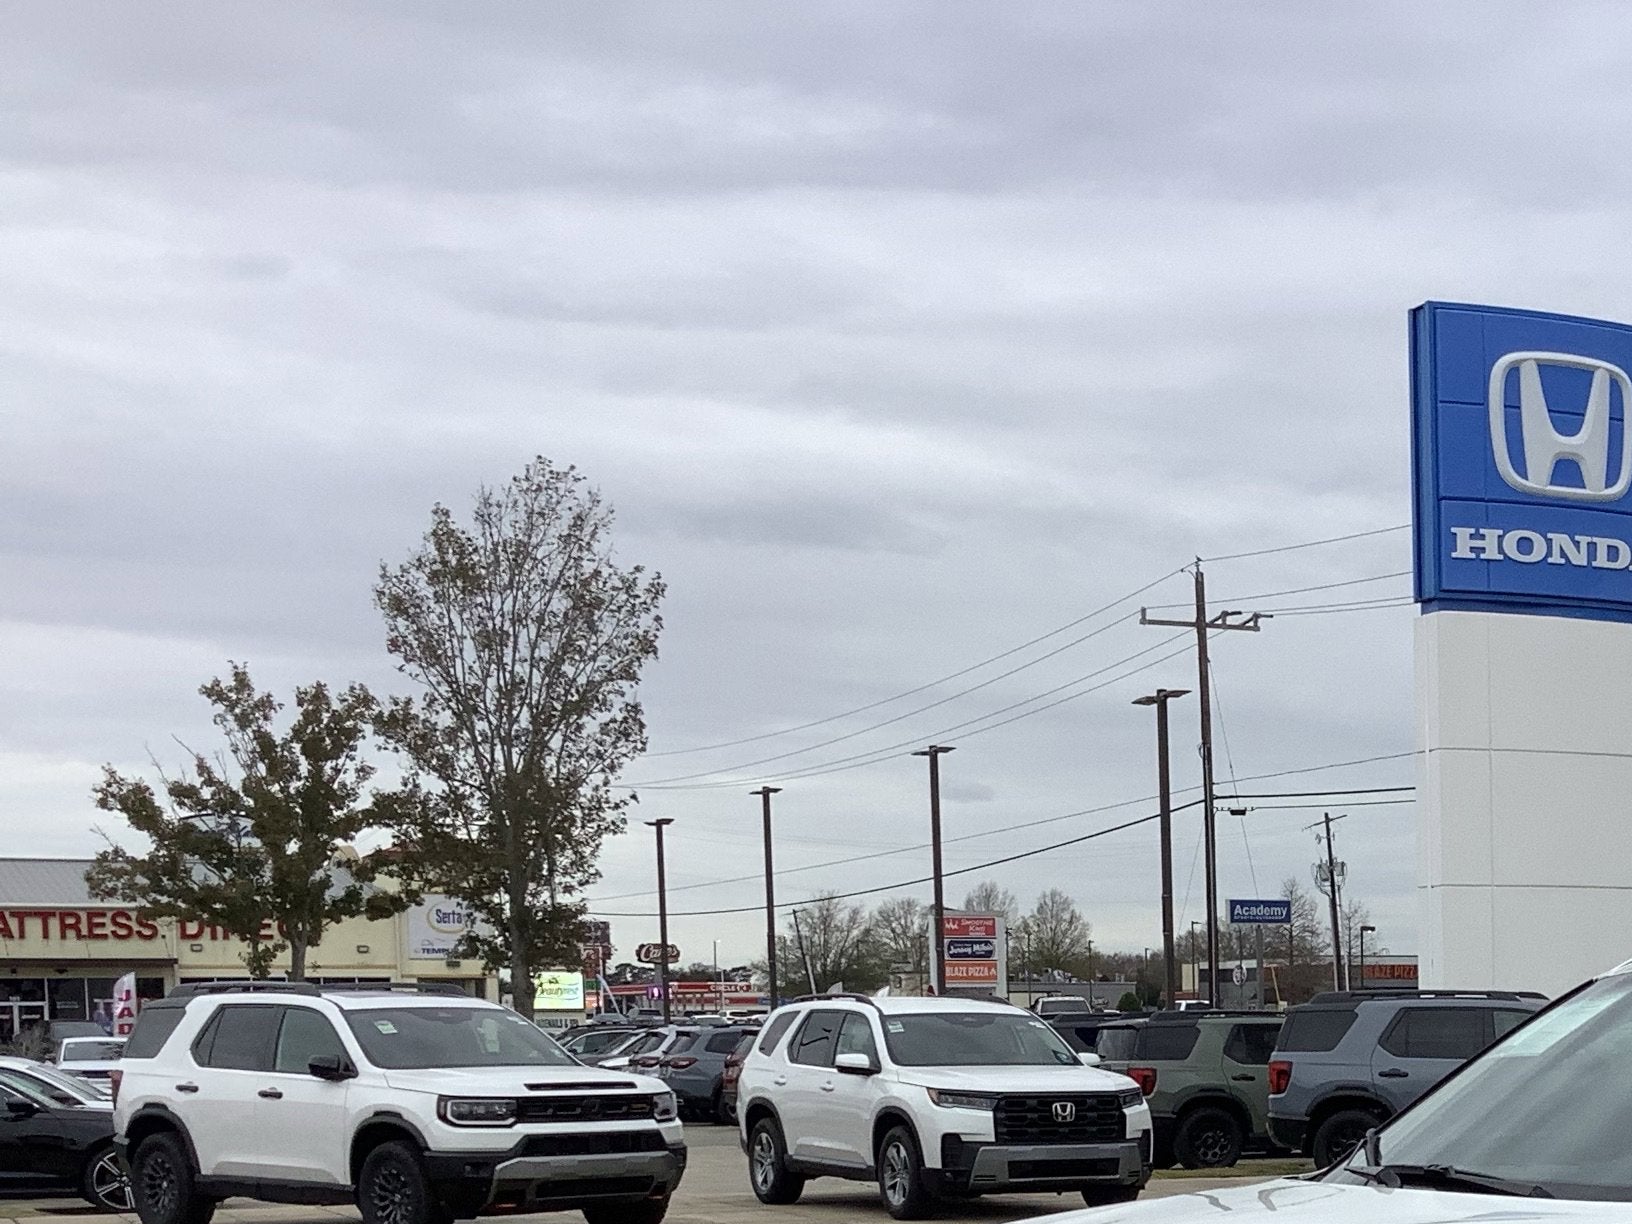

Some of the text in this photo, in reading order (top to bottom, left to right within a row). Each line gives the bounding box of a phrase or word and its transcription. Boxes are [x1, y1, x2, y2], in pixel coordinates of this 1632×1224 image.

[435, 908, 463, 924] Serta
[1233, 904, 1288, 919] Academy
[945, 966, 989, 977] BLAZE PIZZA
